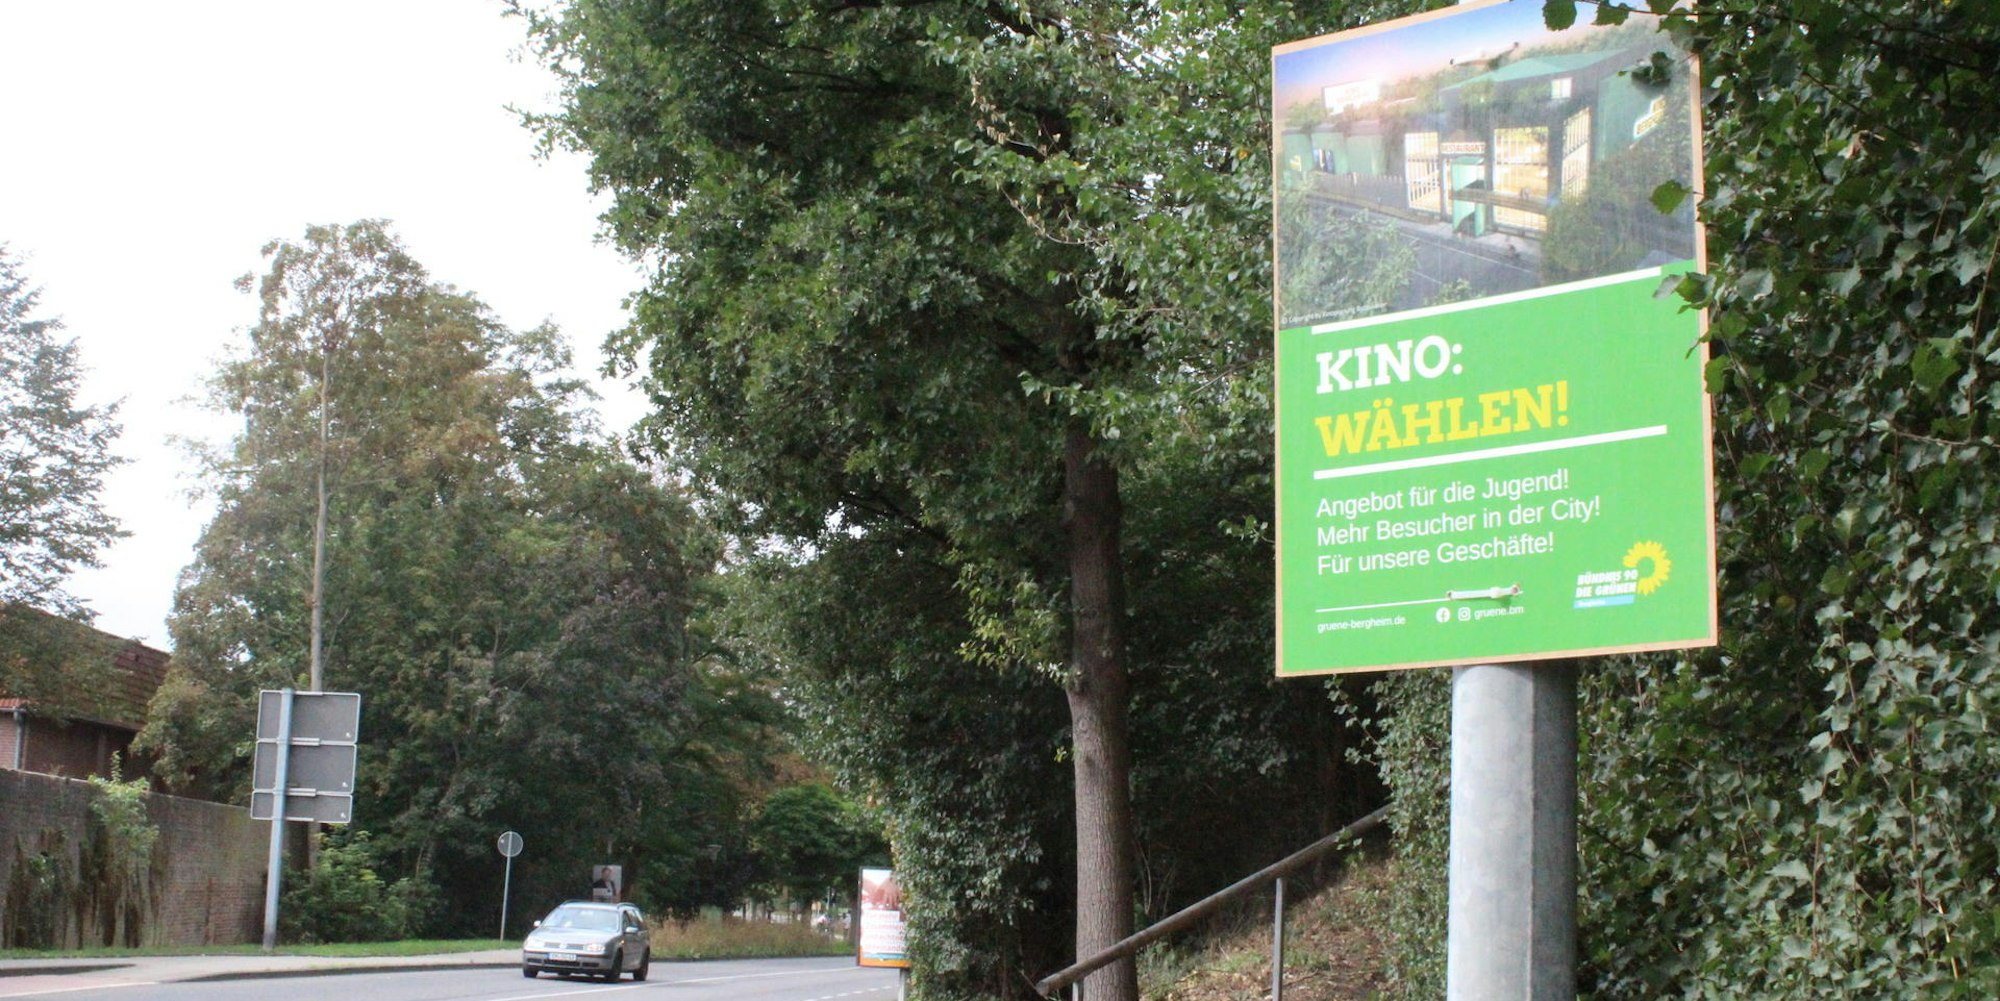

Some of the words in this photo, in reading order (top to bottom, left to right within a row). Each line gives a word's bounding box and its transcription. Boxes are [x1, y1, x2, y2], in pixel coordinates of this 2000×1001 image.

[1316, 335, 1463, 393] KINO:
[1315, 381, 1568, 456] WÄHLEN!
[1316, 491, 1403, 520] Angebot
[1409, 487, 1437, 507] für
[1443, 481, 1475, 503] die
[1482, 469, 1569, 501] Jugend!
[1318, 524, 1370, 547] Mehr
[1377, 512, 1477, 540] Besucher
[1483, 508, 1502, 529] in
[1508, 504, 1544, 526] der
[1551, 496, 1600, 523] City!
[1318, 554, 1353, 576] Für
[1359, 549, 1431, 571] unsere
[1437, 533, 1554, 563] Geschäfte!
[1577, 571, 1622, 586] BÜNDNIS
[1623, 569, 1638, 582] 90
[1575, 586, 1592, 598] DIE
[1594, 582, 1637, 597] GRÜNEN
[1317, 615, 1406, 634] gruene-bergheim.de
